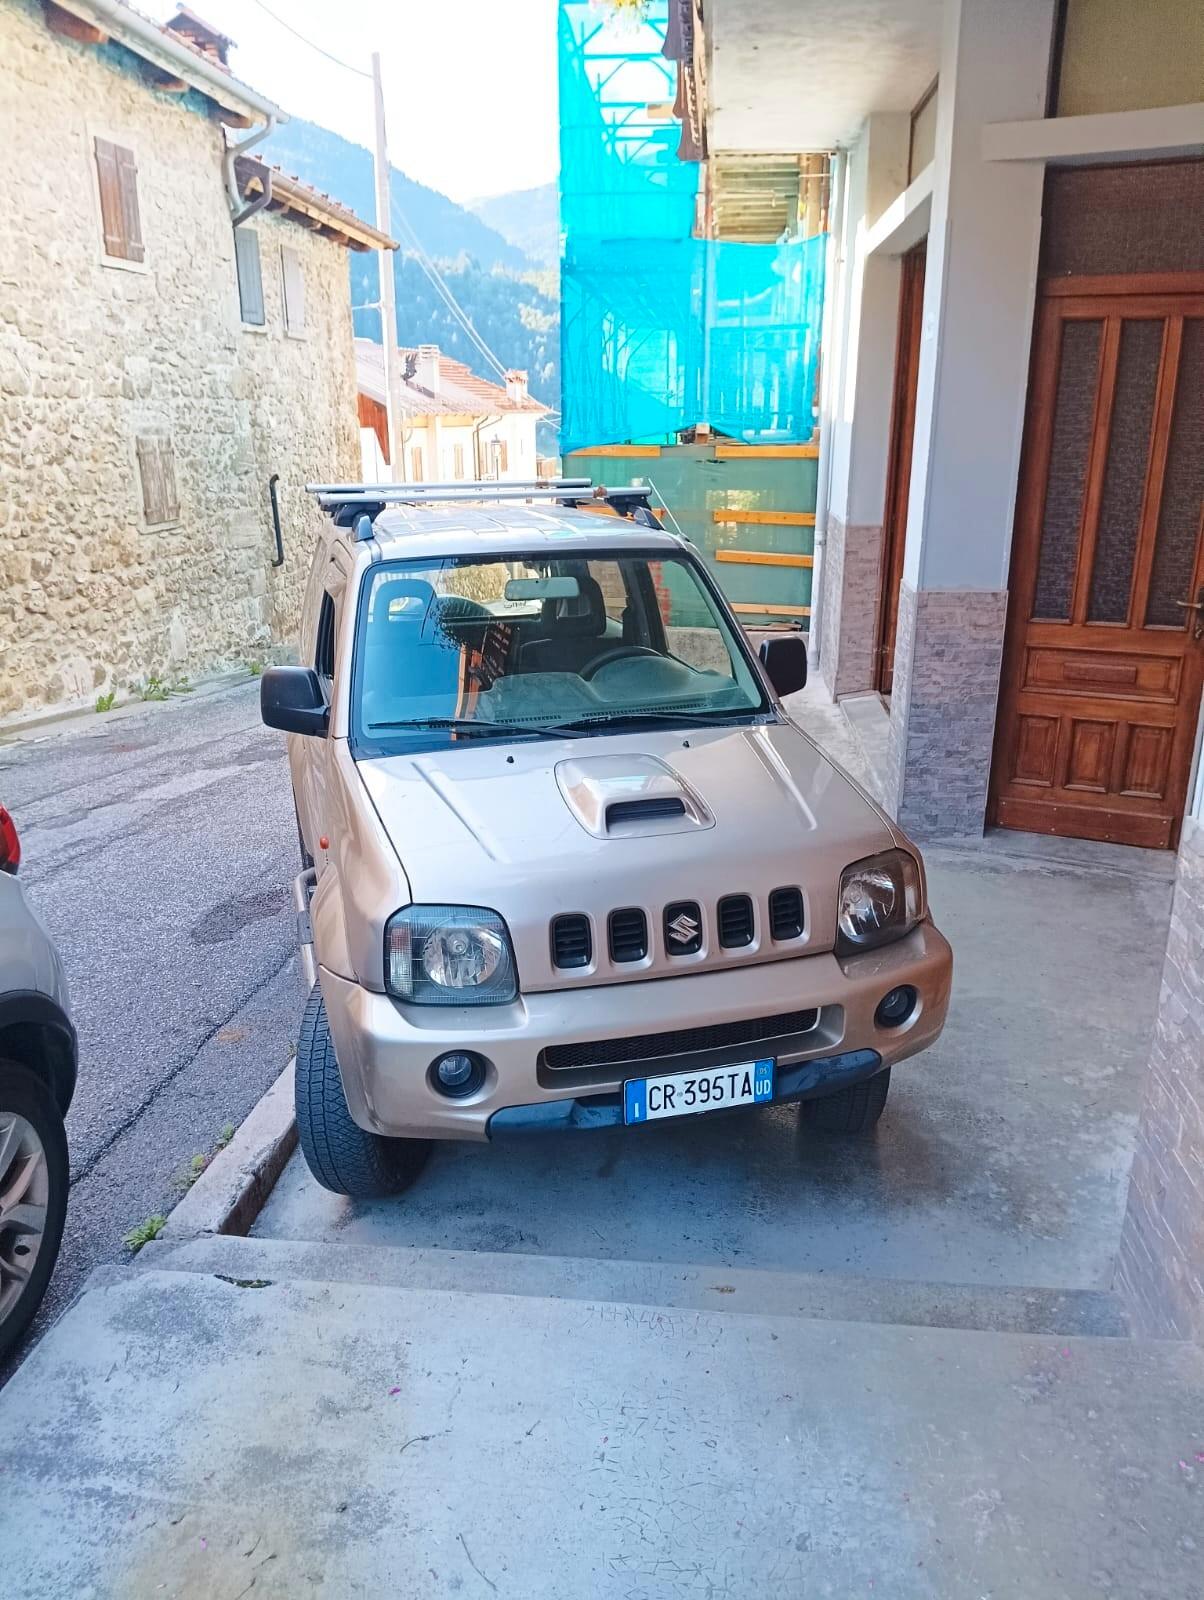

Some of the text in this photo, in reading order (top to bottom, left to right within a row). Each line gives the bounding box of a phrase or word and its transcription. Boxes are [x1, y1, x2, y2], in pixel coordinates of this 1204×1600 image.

[648, 1071, 752, 1111] CR 395TA
[755, 1079, 772, 1096] UD
